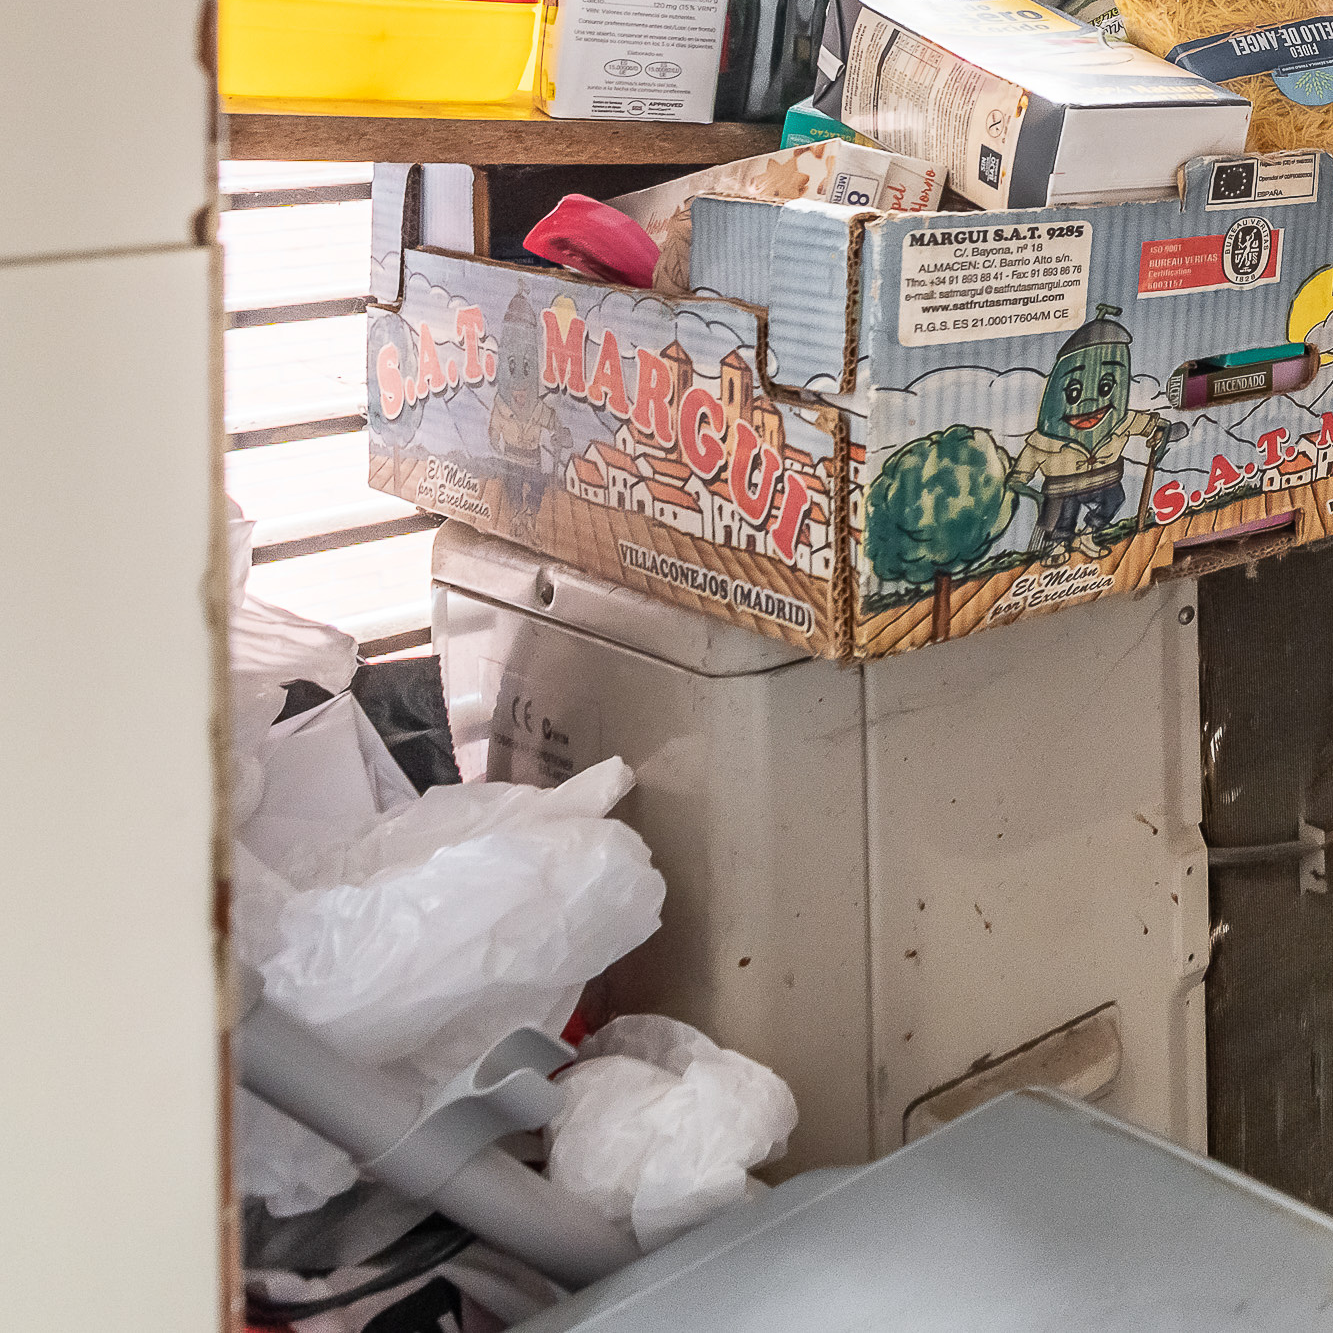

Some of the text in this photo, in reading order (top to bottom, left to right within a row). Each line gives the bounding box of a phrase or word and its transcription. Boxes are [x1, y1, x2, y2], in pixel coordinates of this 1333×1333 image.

[1229, 31, 1279, 56] ÁNGEL
[1284, 28, 1305, 46] DE
[1290, 43, 1319, 58] FIDEO
[848, 191, 869, 206] 8
[910, 167, 936, 211] Horno
[1257, 189, 1283, 197] ESPAÑA
[909, 225, 1084, 247] MARGUI S.A.T. 9285
[1225, 219, 1269, 255] BUREAU VERITAS
[953, 248, 969, 258] C/.
[972, 246, 1013, 257] Bayona,
[1032, 243, 1043, 252] 18
[1150, 244, 1182, 254] ISO 9001
[918, 254, 1073, 273] ALMACEN: C/. Barrio Alto s/n.
[1149, 253, 1218, 268] BUREAU VERITAS
[929, 277, 946, 286] +34
[950, 276, 959, 285] 91
[962, 275, 978, 283] 893
[993, 272, 1003, 281] 41
[1012, 270, 1028, 279] Fax:
[1031, 268, 1039, 278] 91
[1043, 268, 1058, 276] 893
[1060, 266, 1071, 275] 86
[1072, 265, 1082, 274] 76
[1148, 268, 1192, 278] Certification
[1235, 274, 1256, 282] 1828
[905, 291, 937, 301] e-mail:
[921, 292, 1065, 314] www.satfrutasmargui.com
[914, 309, 1069, 333] R.G.S. ES 21.00017604/M CE
[1213, 373, 1266, 395] HACENDADO
[376, 305, 811, 566] S.A.T. MARGUI
[428, 459, 478, 493] El Melón
[1152, 426, 1297, 525] S.A.T.
[417, 482, 434, 497] por
[618, 540, 816, 634] VILLACONEJOS (MADRID)
[1012, 566, 1099, 598] El Melón
[989, 577, 1113, 621] por Excelencia
